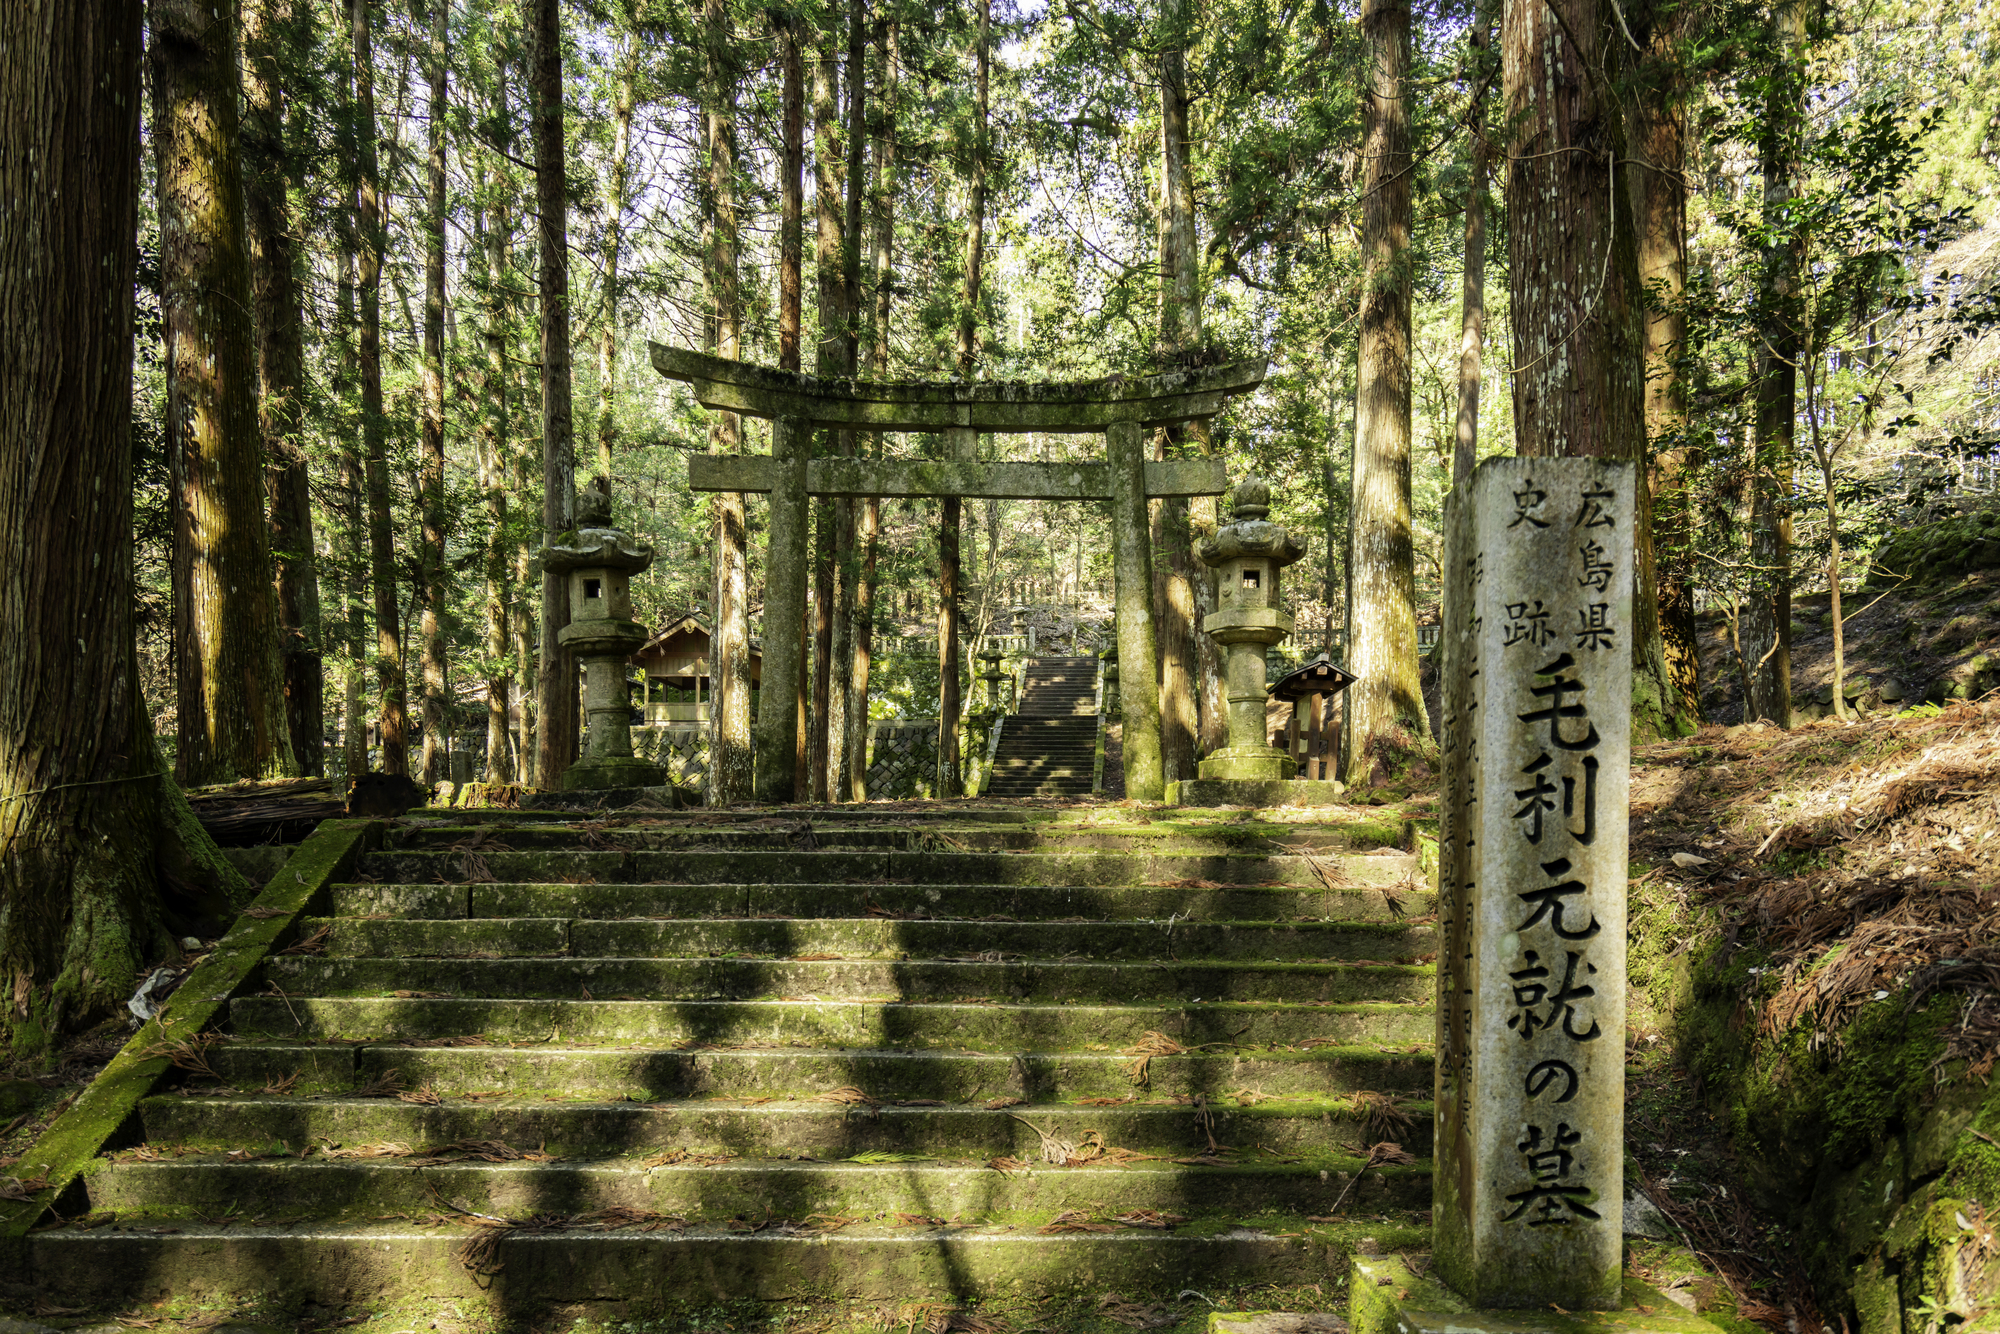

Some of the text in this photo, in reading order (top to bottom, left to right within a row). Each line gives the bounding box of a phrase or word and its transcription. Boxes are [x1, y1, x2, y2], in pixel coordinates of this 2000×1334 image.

[1503, 479, 1556, 648] 史跡
[1574, 482, 1616, 653] 広島県
[1503, 652, 1601, 1228] 毛利元就の墓
